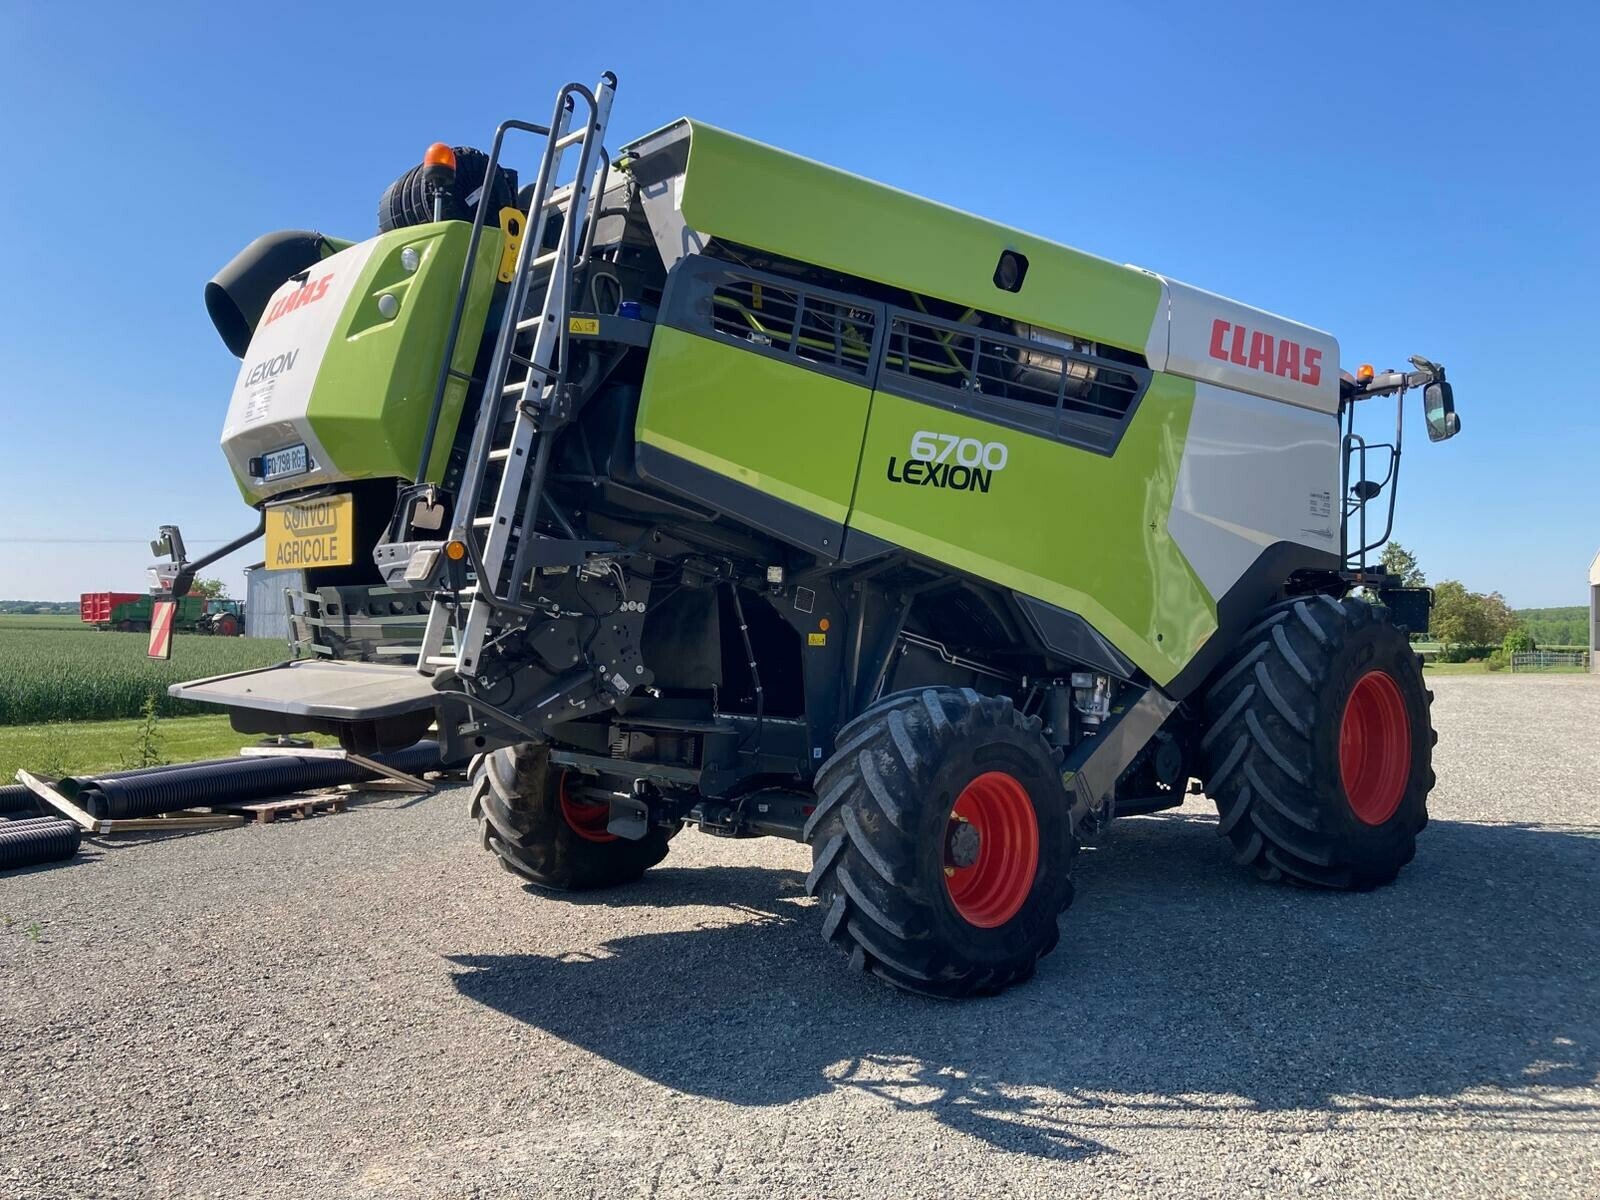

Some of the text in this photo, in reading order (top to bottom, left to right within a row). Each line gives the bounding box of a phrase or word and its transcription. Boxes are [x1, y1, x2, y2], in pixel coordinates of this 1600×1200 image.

[264, 273, 335, 327] CLAAS
[245, 348, 299, 388] LEXION
[1209, 319, 1322, 386] CLAAS
[911, 431, 1008, 471] 6700
[887, 456, 993, 493] LEXION
[283, 502, 330, 530] CONVOI
[276, 537, 338, 565] AGRICOLE
